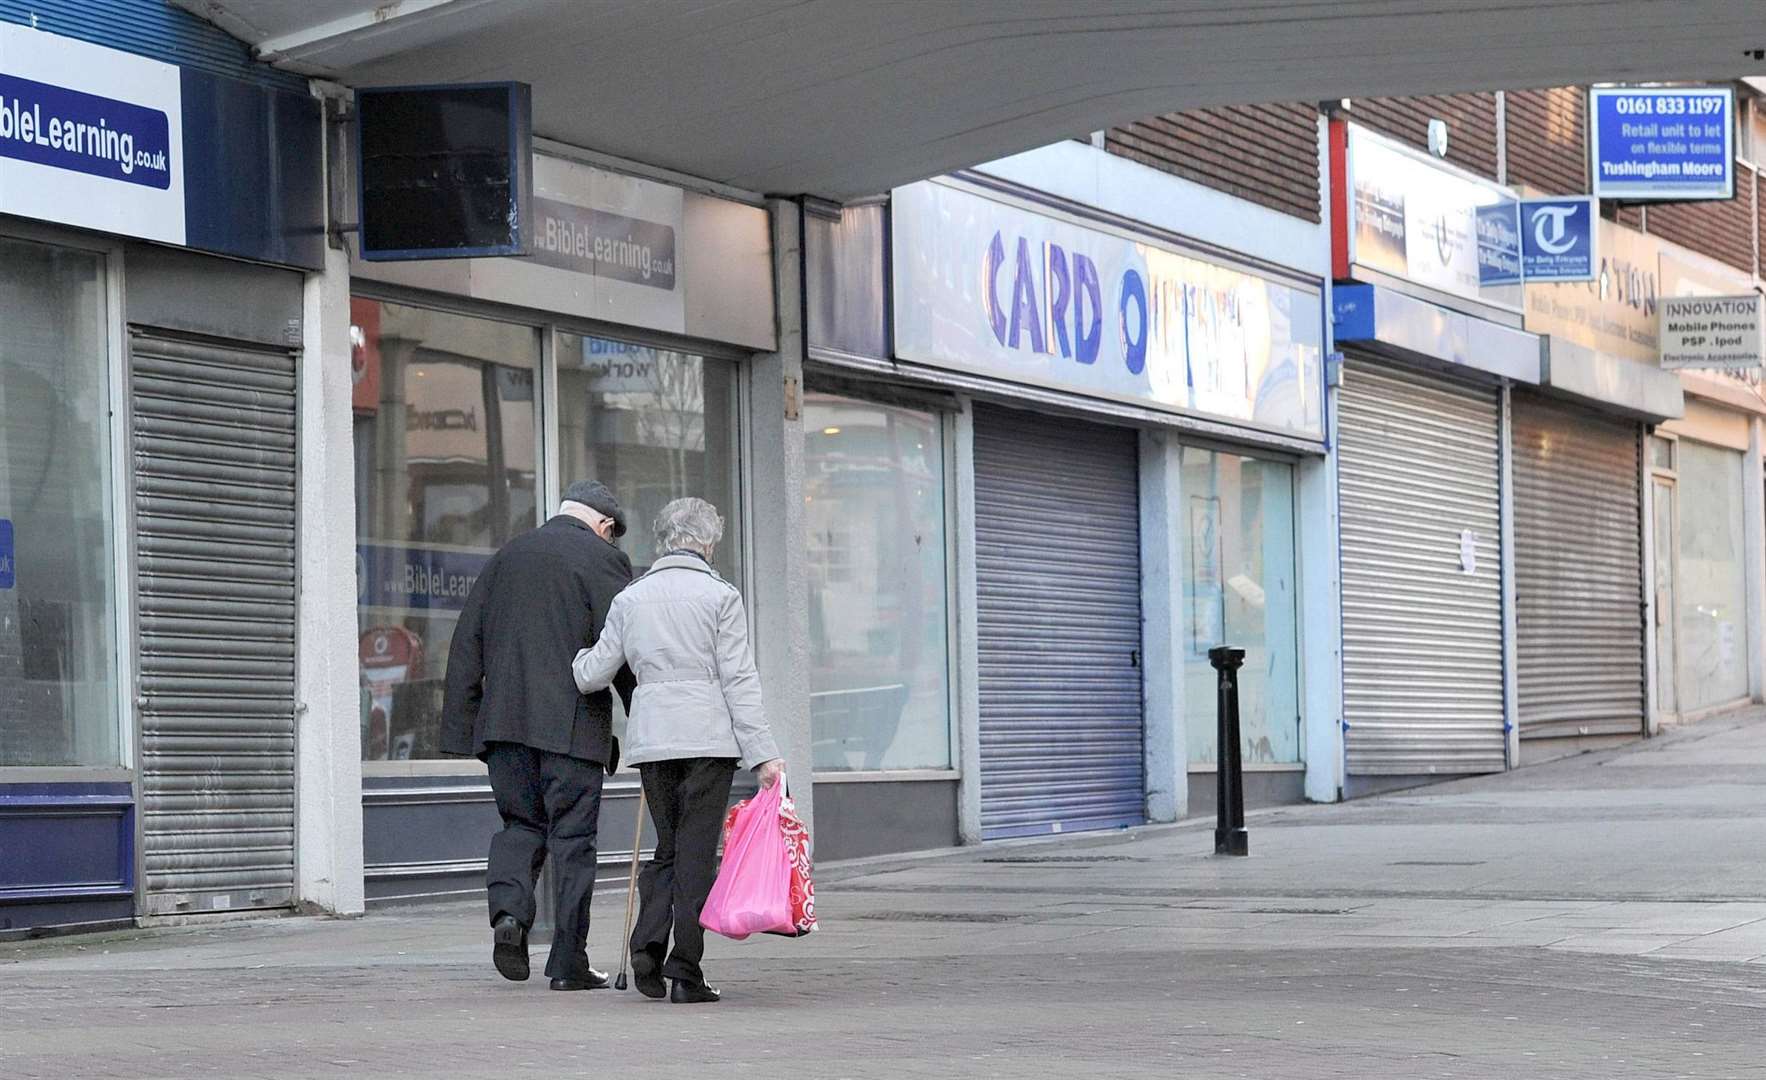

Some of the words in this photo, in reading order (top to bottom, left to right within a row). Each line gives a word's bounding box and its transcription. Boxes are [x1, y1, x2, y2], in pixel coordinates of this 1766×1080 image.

[1616, 97, 1652, 114] 0161
[1656, 97, 1685, 114] 833
[1689, 97, 1722, 114] 1197
[1622, 123, 1657, 137] Retail
[1662, 123, 1685, 137] unit
[1689, 124, 1701, 137] to
[1705, 123, 1721, 137] let
[1631, 144, 1645, 154] on
[1648, 141, 1687, 154] flexible
[1690, 142, 1721, 154] terms
[1602, 160, 1680, 177] Tushingham
[1682, 162, 1722, 175] Moore
[981, 230, 1103, 365] CARD
[1666, 302, 1757, 317] INNOVATION
[1668, 322, 1708, 333] Mobile
[1710, 322, 1756, 331] Phones
[1681, 336, 1706, 346] PSP
